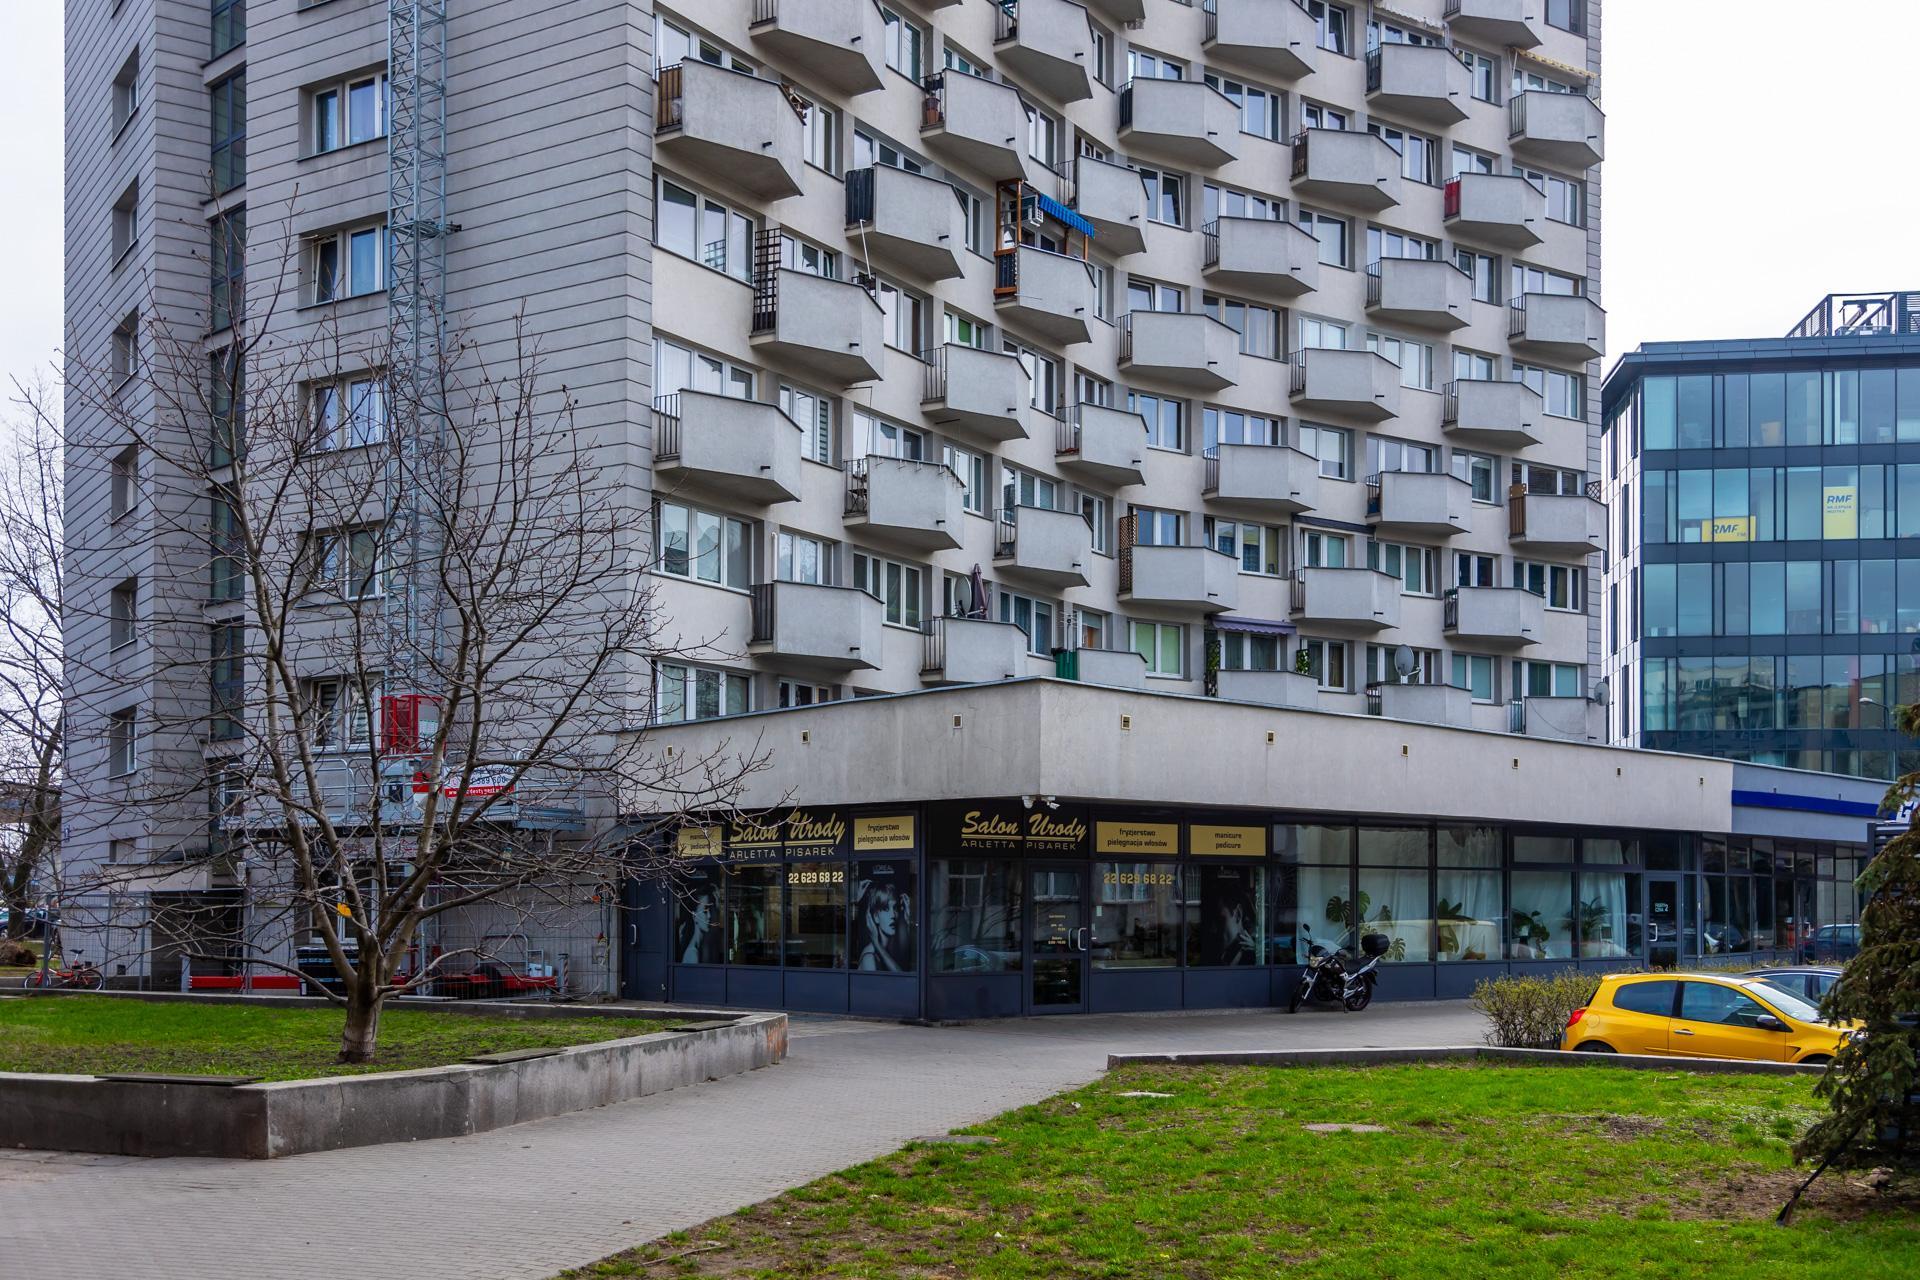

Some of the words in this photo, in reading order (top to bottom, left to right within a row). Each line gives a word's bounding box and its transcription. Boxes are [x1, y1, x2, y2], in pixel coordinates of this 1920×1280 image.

[1827, 495, 1853, 504] RMF
[1711, 524, 1739, 535] RMF
[729, 814, 779, 842] Salon
[787, 810, 846, 845] Urody
[961, 810, 1019, 834] Salon
[1029, 813, 1087, 842] Urody
[1214, 831, 1242, 839] manicure
[961, 840, 1016, 849] ARLETTA
[1026, 842, 1076, 850] PISAREK
[1215, 841, 1242, 849] pedicure
[729, 849, 777, 859] ARLETTA
[785, 846, 835, 857] PISAREK
[788, 873, 799, 884] 22
[801, 873, 817, 883] 629
[819, 872, 830, 883] 68
[832, 871, 844, 882] 22
[1103, 873, 1117, 884] 22
[1120, 873, 1140, 884] 629
[1143, 873, 1157, 884] 68
[1159, 873, 1173, 884] 22
